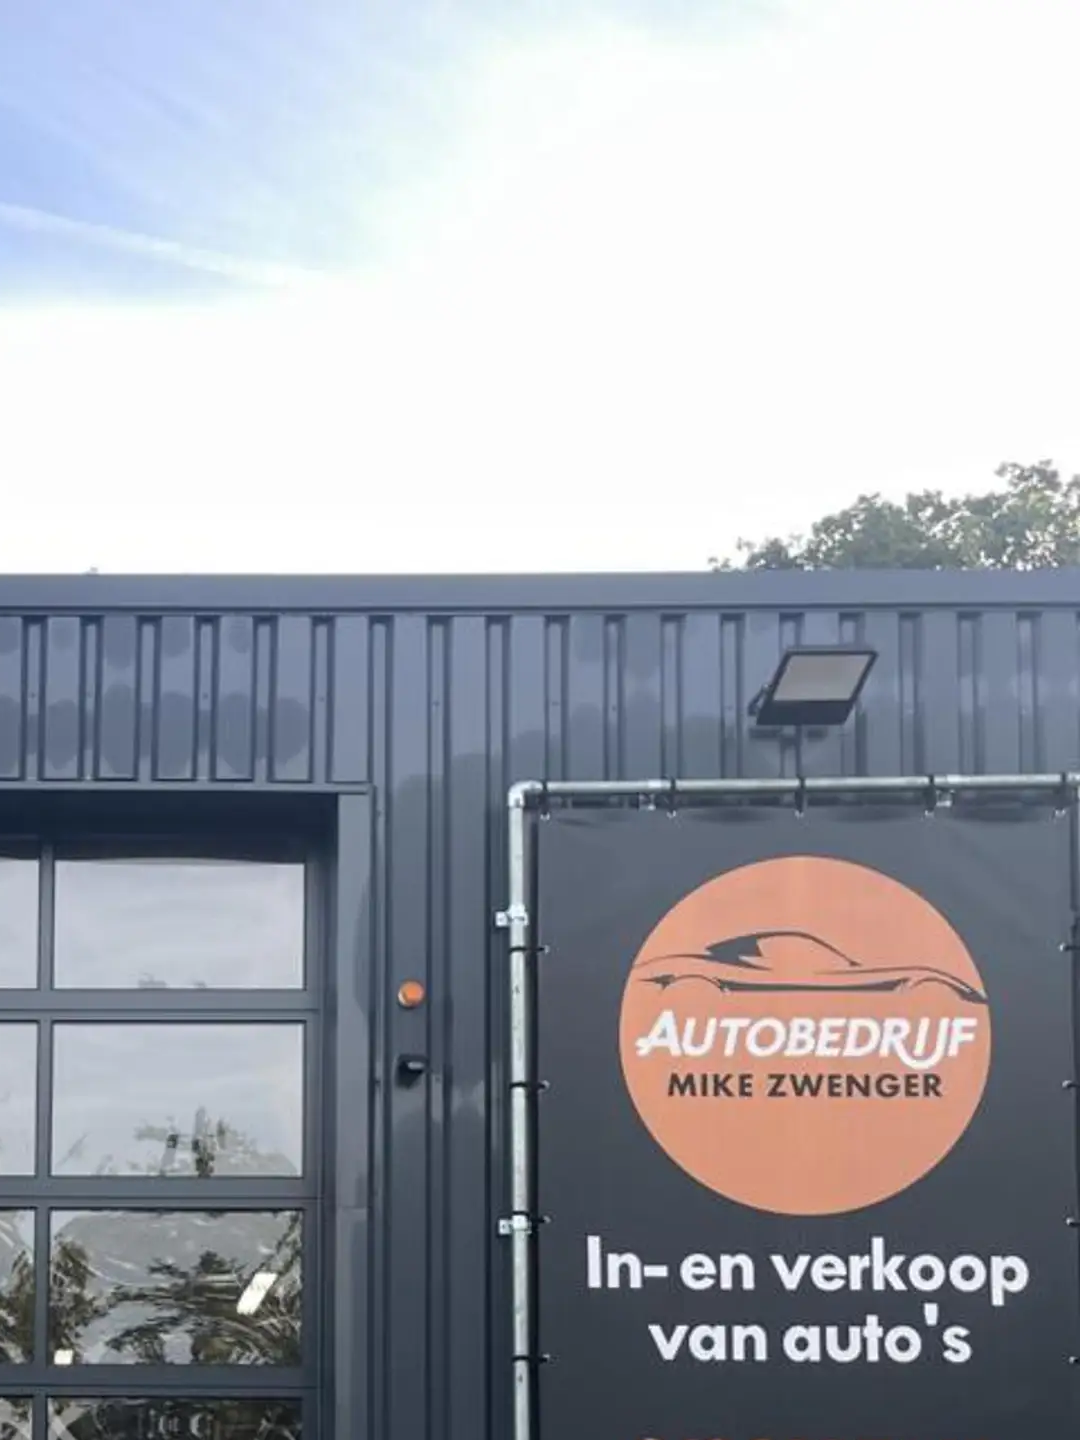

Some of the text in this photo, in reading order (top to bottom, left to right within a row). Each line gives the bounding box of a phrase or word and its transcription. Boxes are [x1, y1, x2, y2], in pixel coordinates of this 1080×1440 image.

[636, 1010, 977, 1070] AUTOBEDRIJF
[667, 1073, 942, 1098] MIKE ZWENGER
[587, 1235, 1029, 1306] In- en verkoop
[648, 1302, 972, 1363] van auto's
